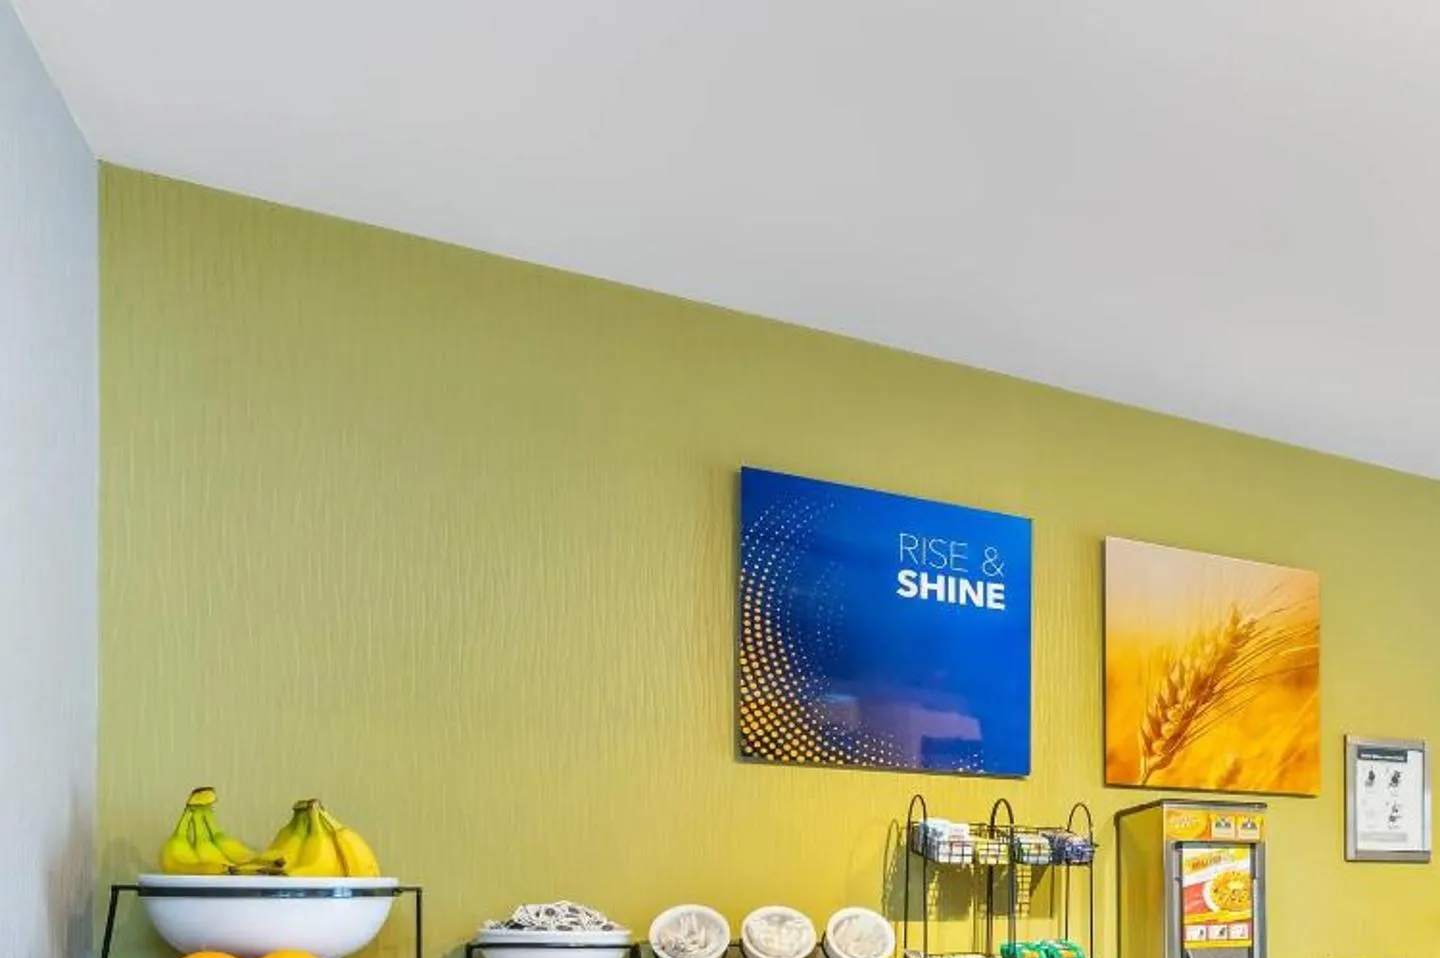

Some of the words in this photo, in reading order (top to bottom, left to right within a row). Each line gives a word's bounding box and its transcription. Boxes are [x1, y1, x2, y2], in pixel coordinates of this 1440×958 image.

[899, 532, 969, 573] RISE
[982, 546, 1005, 578] &
[896, 569, 1006, 611] SHINE
